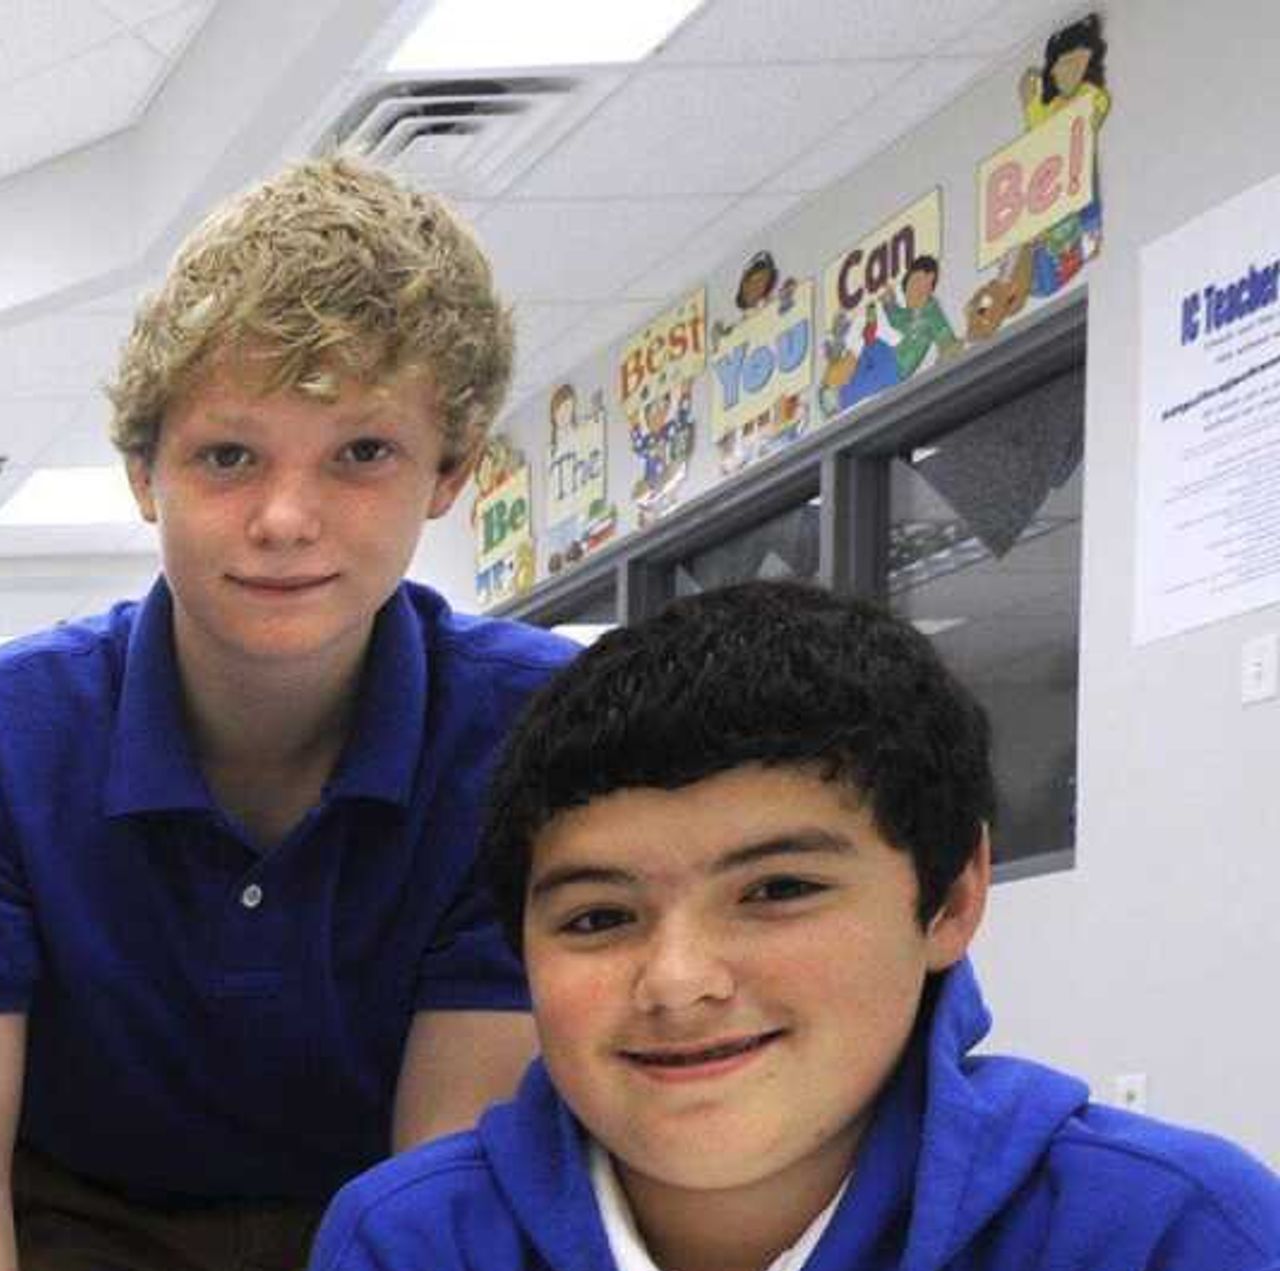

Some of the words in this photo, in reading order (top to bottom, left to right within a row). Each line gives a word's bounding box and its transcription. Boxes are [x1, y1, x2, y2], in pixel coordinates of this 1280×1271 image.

[482, 499, 527, 554] Be
[551, 451, 600, 500] The
[620, 310, 704, 400] Best
[838, 224, 916, 309] Can
[986, 116, 1085, 243] Be!
